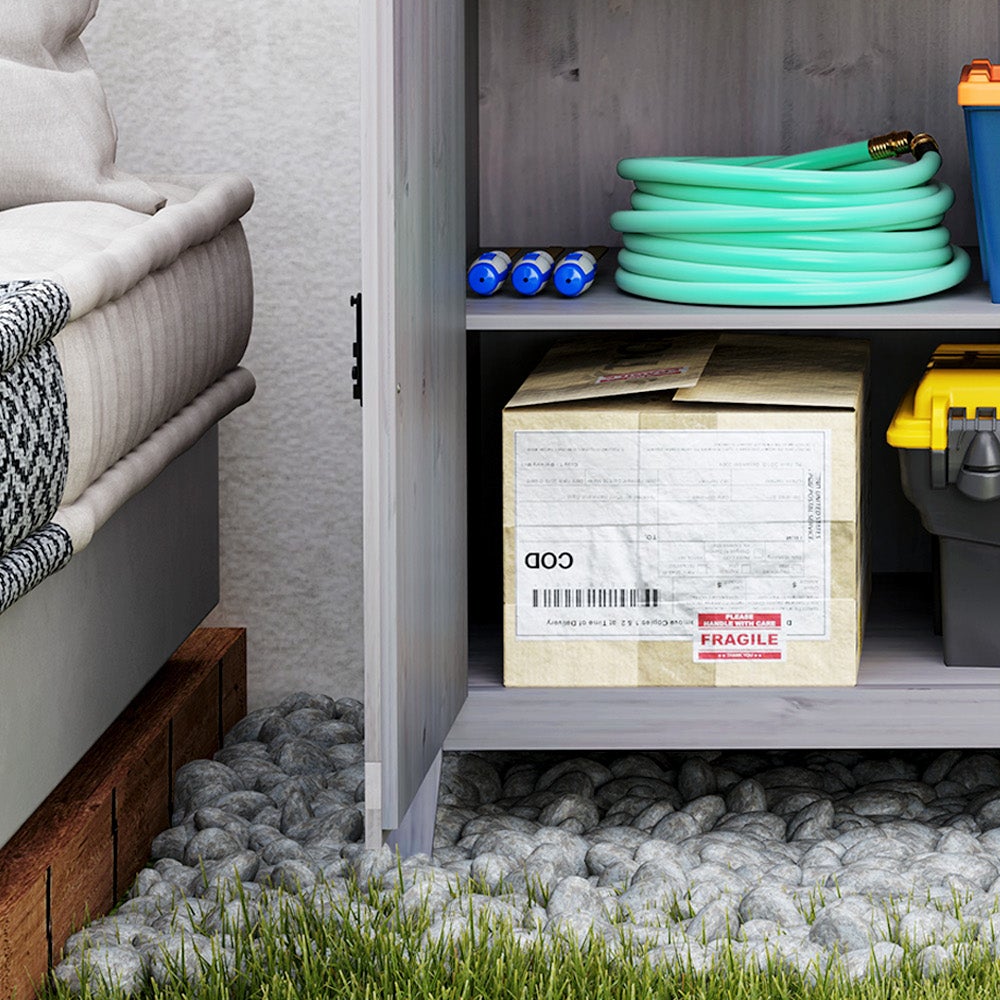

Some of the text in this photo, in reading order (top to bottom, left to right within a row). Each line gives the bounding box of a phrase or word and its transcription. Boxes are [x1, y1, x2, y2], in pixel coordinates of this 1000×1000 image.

[524, 551, 574, 570] COD
[546, 618, 577, 628] Delivery
[588, 619, 607, 627] Time
[641, 618, 669, 627] Copies
[701, 633, 779, 646] FRAGILE
